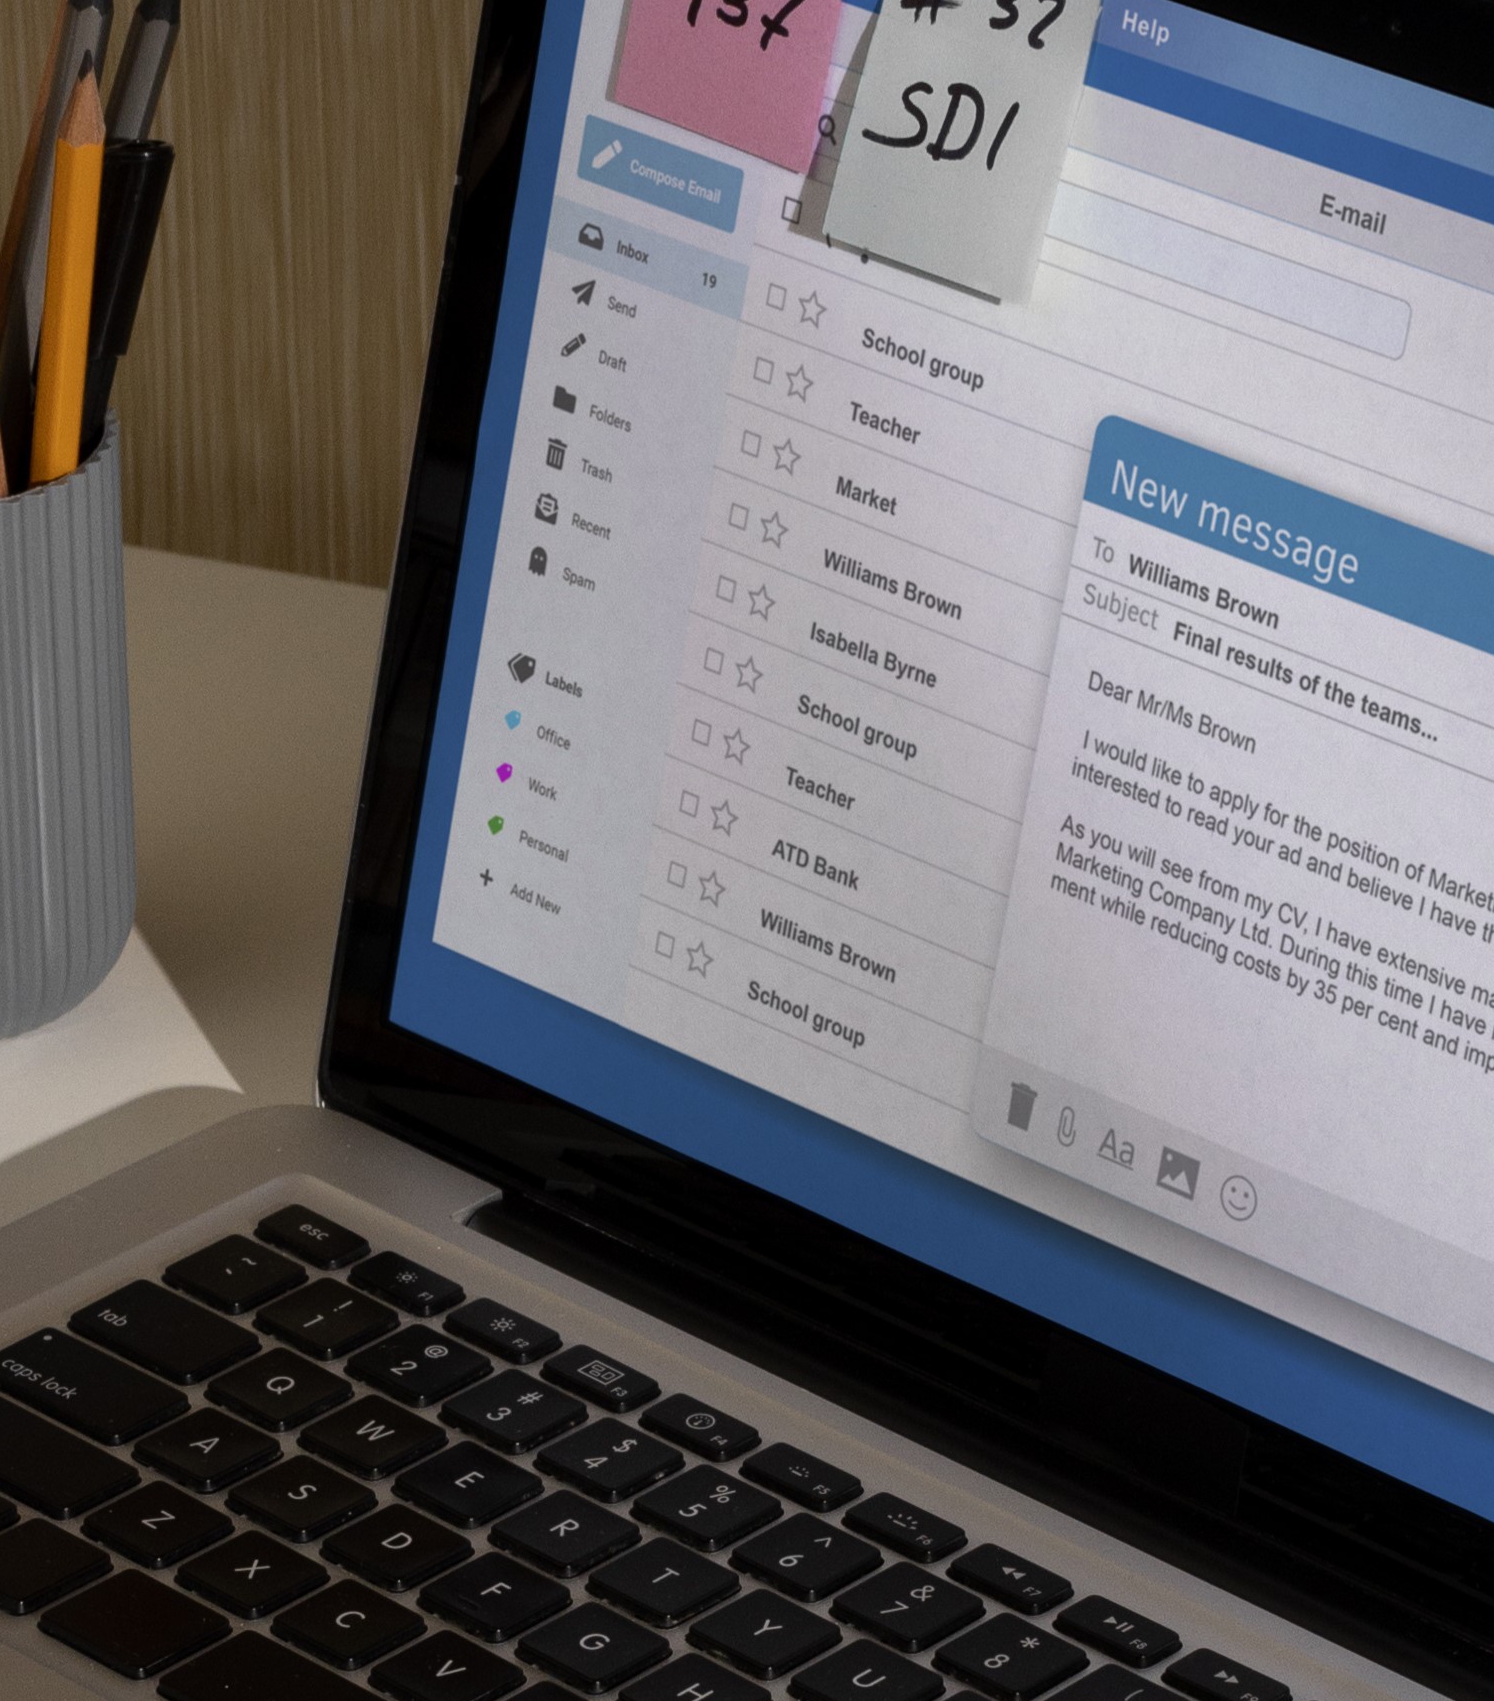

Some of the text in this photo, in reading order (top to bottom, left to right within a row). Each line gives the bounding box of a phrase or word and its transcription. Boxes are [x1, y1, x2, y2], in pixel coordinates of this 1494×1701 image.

[1122, 9, 1170, 46] Help
[630, 159, 721, 203] Compose Email
[1320, 194, 1386, 235] E-mail
[616, 240, 649, 264] Inbox
[703, 272, 717, 288] 19
[607, 296, 637, 318] Send
[598, 350, 627, 372] Draft
[862, 328, 984, 392] School group
[589, 404, 631, 432] Folders
[851, 401, 921, 444] Teacher
[582, 458, 612, 483] Trash
[836, 476, 897, 516] Market
[572, 513, 611, 540] Recent
[1112, 459, 1358, 583] New message
[563, 567, 595, 591] Spam
[824, 549, 962, 620] Williams Brown
[1094, 537, 1279, 629] To Williams Brown
[810, 622, 937, 688] Isabella Byrne
[1084, 584, 1437, 742] Subject Final results of the teams...
[545, 671, 582, 698] Labels
[798, 694, 917, 761] School group
[1088, 670, 1256, 754] Dear Mr/Ms Brown
[537, 725, 571, 750] Office
[529, 777, 557, 801] Work
[786, 766, 855, 810] Teacher
[1083, 730, 1090, 749] I
[1094, 739, 1147, 772] would
[1152, 757, 1182, 786] like
[1187, 773, 1204, 794] to
[1209, 785, 1259, 820] apply
[1264, 802, 1289, 828] for
[1294, 815, 1322, 842] the
[1326, 832, 1399, 873] position
[1405, 863, 1426, 882] of
[519, 830, 569, 862] Personal
[772, 839, 859, 890] ATD Bank
[1072, 757, 1160, 809] interested
[1165, 795, 1182, 817] to
[1187, 808, 1229, 836] read
[1232, 826, 1275, 854] your
[1278, 844, 1302, 866] ad
[1306, 856, 1343, 882] and
[1347, 868, 1413, 911] believe
[1419, 896, 1425, 916] I
[1430, 901, 1476, 936] have
[510, 884, 561, 915] Add New
[1060, 814, 1085, 839] As
[1089, 830, 1122, 855] you
[1128, 845, 1156, 868] will
[1161, 859, 1193, 883] see
[1199, 870, 1239, 902] from
[1244, 893, 1273, 919] my
[1278, 902, 1308, 934] CV,
[1315, 917, 1322, 936] I
[1326, 922, 1372, 956] have
[1377, 947, 1466, 995] extensive
[761, 908, 896, 983] Williams Brown
[1051, 875, 1096, 905] ment
[1101, 895, 1145, 925] while
[1150, 916, 1228, 964] reducing
[1233, 951, 1281, 982] costs
[1286, 968, 1309, 996] by
[1314, 979, 1337, 1004] 35
[1341, 996, 1374, 1019] per
[1378, 1010, 1418, 1039] cent
[1422, 1029, 1459, 1055] and
[747, 980, 865, 1049] School group
[300, 1222, 330, 1241] esc
[98, 1309, 127, 1326] tab
[2, 1359, 76, 1399] caps lock
[266, 1376, 295, 1394] Q
[356, 1420, 394, 1441] W
[455, 1471, 484, 1488] E
